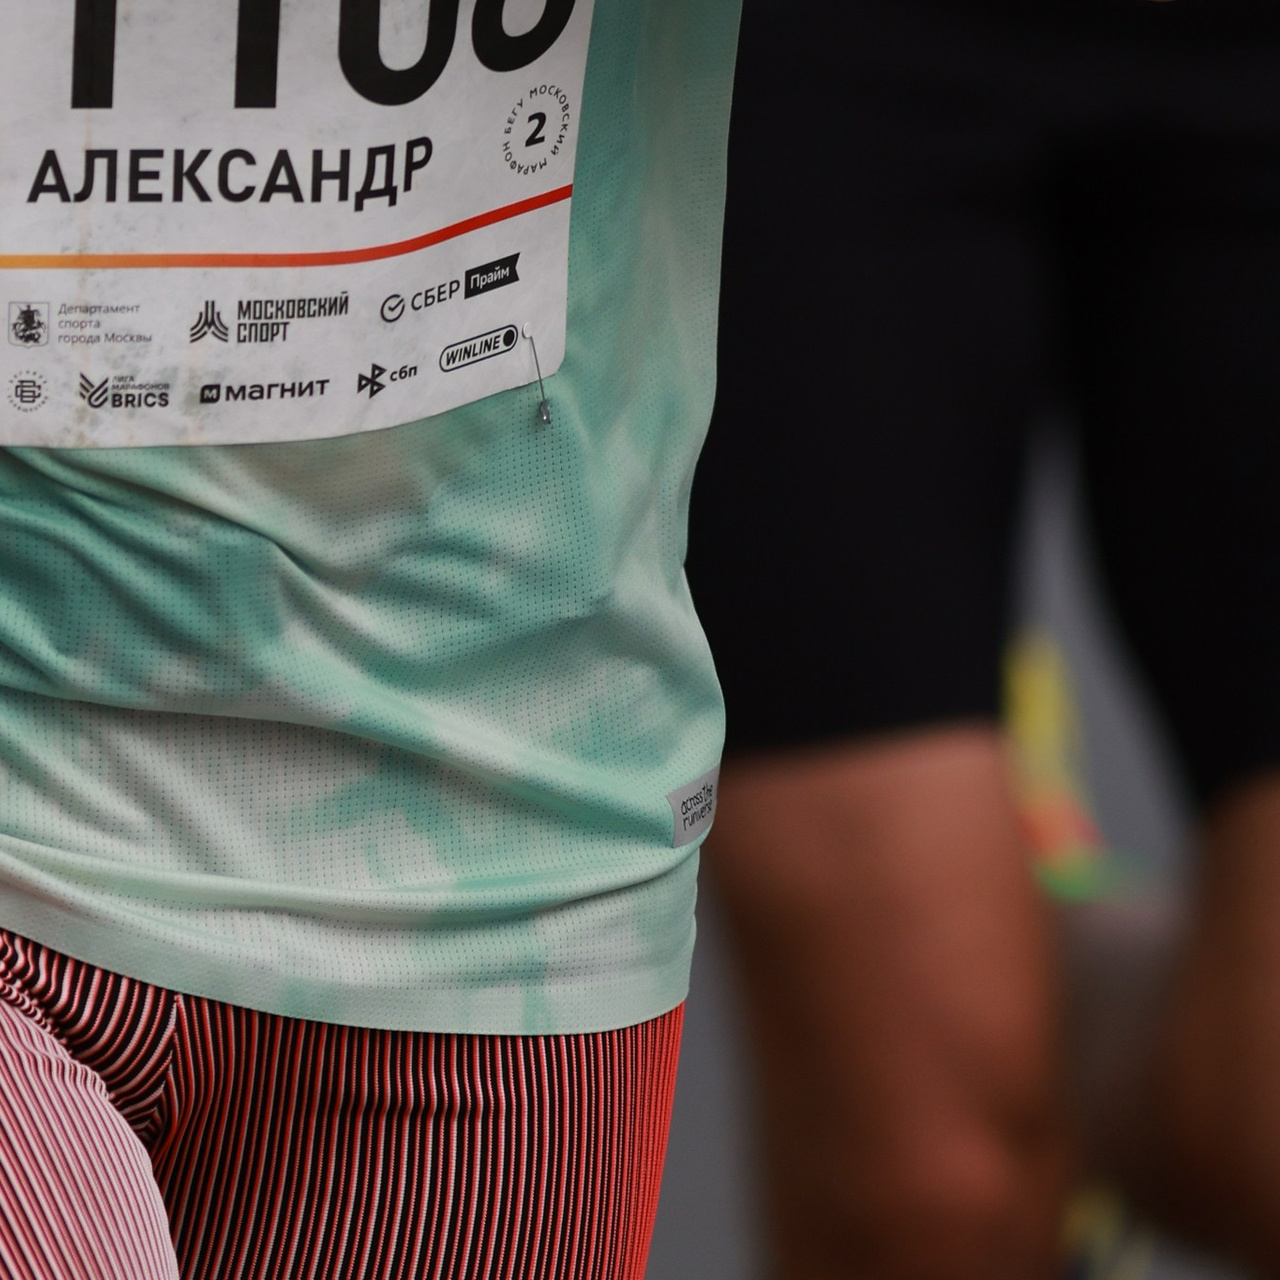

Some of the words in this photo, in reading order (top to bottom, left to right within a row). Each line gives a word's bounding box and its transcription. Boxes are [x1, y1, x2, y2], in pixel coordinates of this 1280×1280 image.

[525, 111, 547, 148] 2
[26, 136, 434, 212] АЛЕКСАНДР
[411, 279, 460, 311] СБЕР
[470, 265, 510, 289] Прайм
[58, 303, 140, 315] Департамент
[237, 291, 349, 320] МОСКОВСКИЙ
[58, 320, 101, 330] спорта
[237, 322, 290, 343] СПОРТ
[58, 334, 100, 345] города
[104, 333, 152, 343] Москвы
[445, 334, 502, 366] WINLINE
[390, 364, 418, 382] сбп
[111, 392, 169, 408] BRICS
[225, 379, 330, 402] магнит
